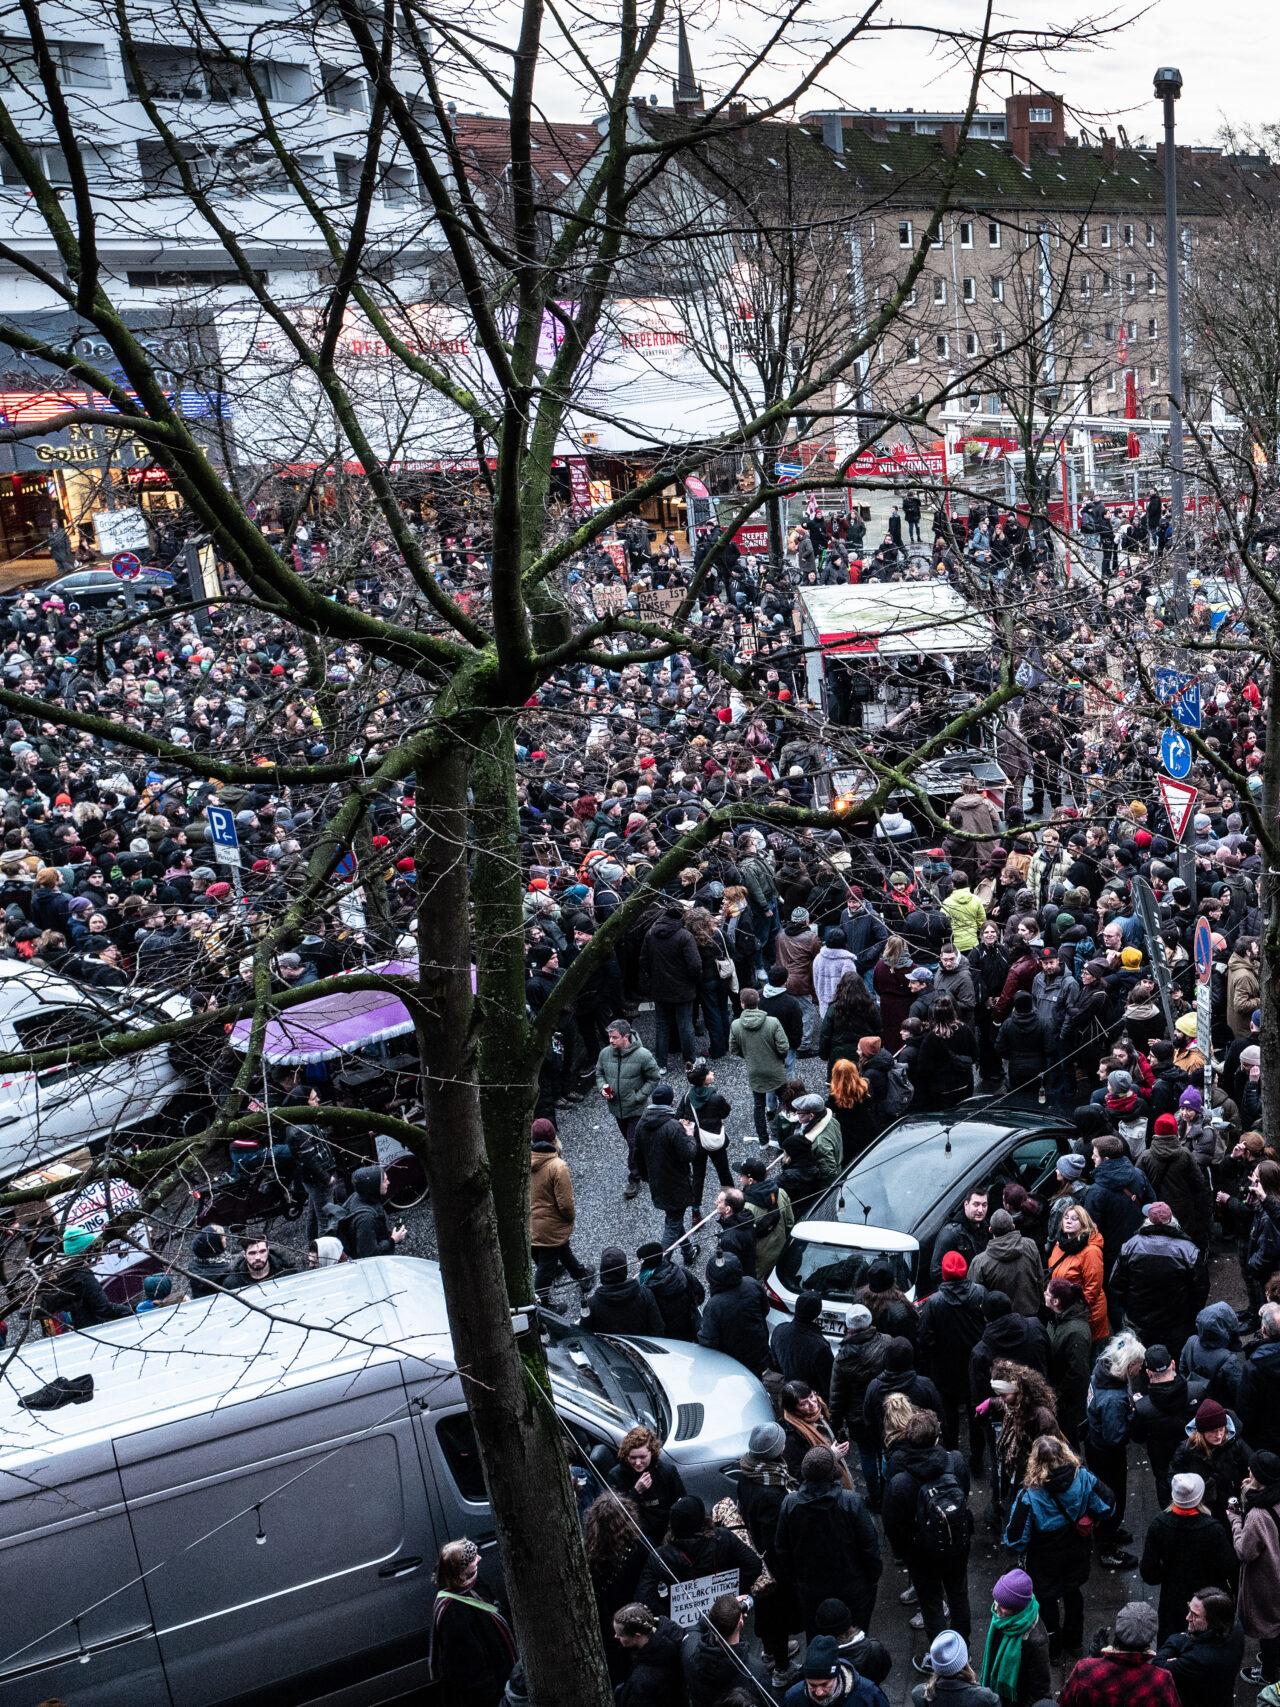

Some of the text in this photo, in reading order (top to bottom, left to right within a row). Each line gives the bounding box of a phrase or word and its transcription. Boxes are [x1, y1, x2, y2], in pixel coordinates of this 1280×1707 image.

[879, 460, 943, 473] WILLKOMMEN
[670, 588, 686, 599] IST
[212, 811, 227, 839] P
